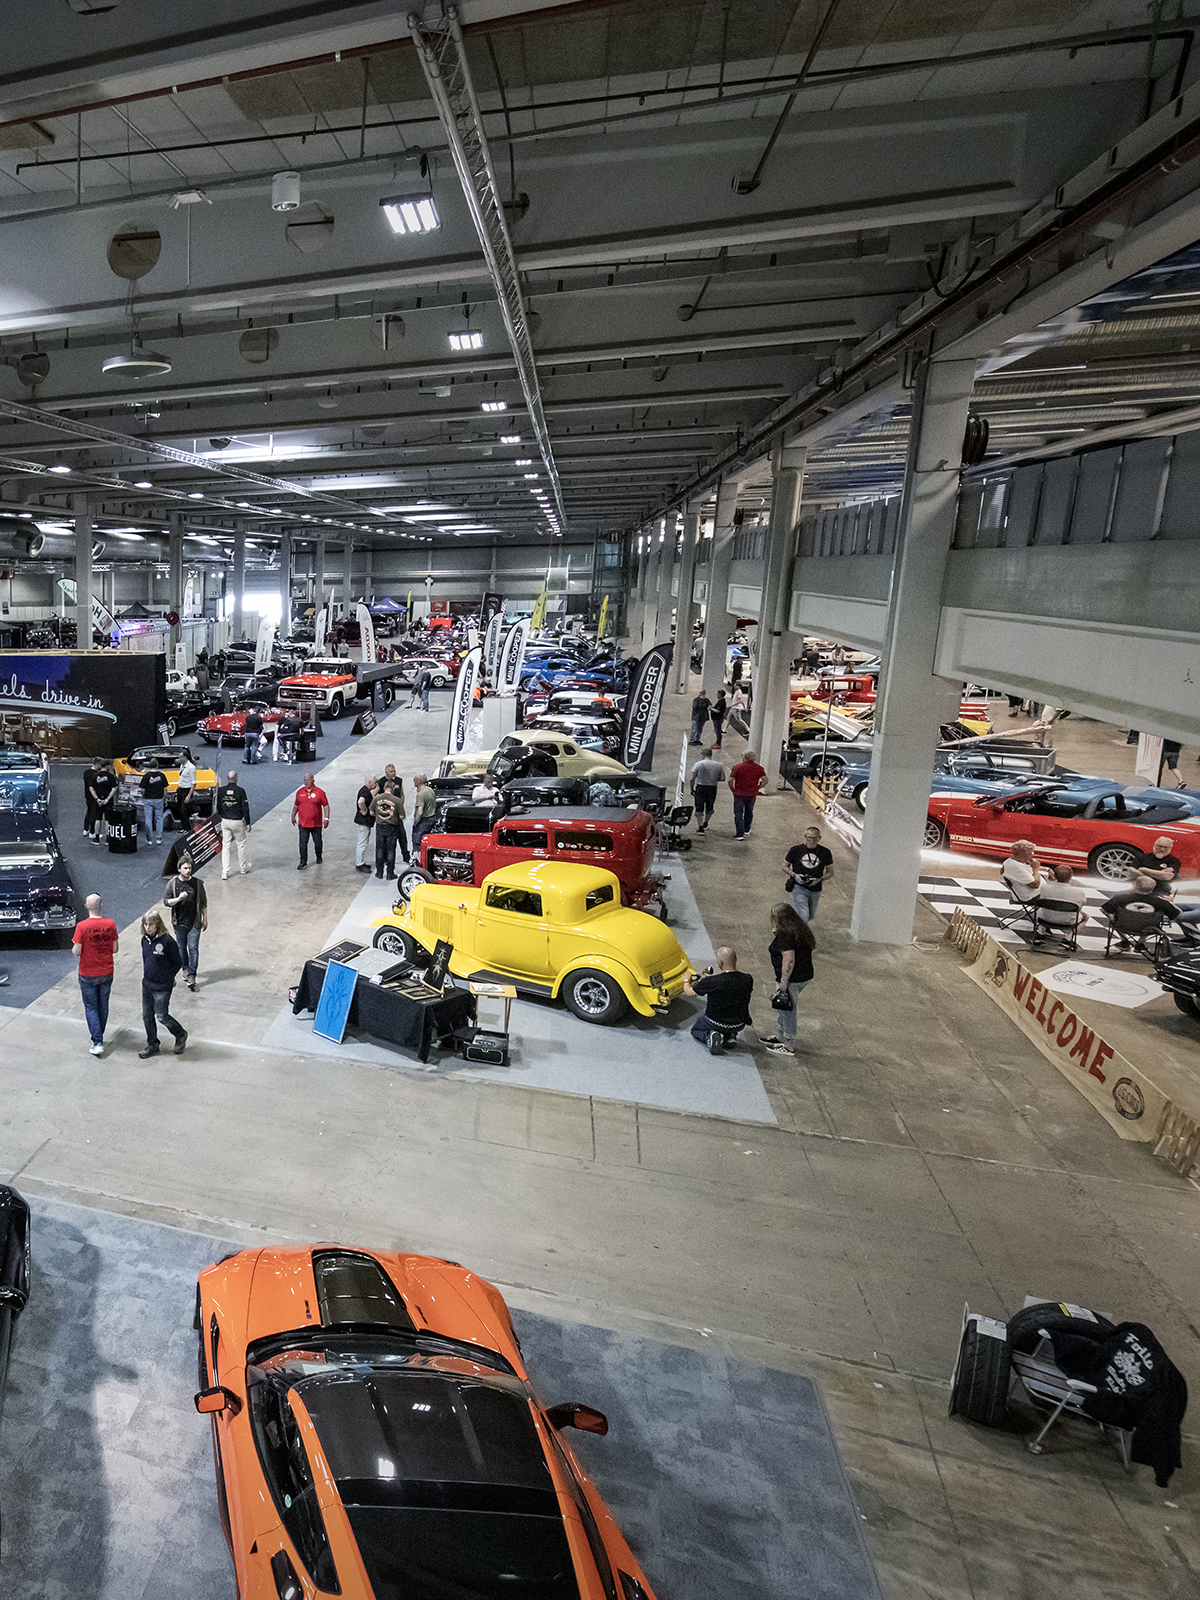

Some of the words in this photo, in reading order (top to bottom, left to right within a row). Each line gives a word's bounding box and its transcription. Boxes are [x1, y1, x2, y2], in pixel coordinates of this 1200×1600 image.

[509, 632, 522, 664] COOPER
[506, 664, 514, 684] MINI
[41, 679, 104, 709] drive-in
[460, 668, 473, 716] COOPER
[628, 727, 644, 754] MINI
[637, 666, 660, 722] COOPER
[648, 702, 658, 723] CLUB
[456, 719, 466, 744] MINI
[107, 824, 126, 838] FUEL
[1013, 963, 1115, 1085] WELCOME
[1124, 1332, 1154, 1371] Follo
